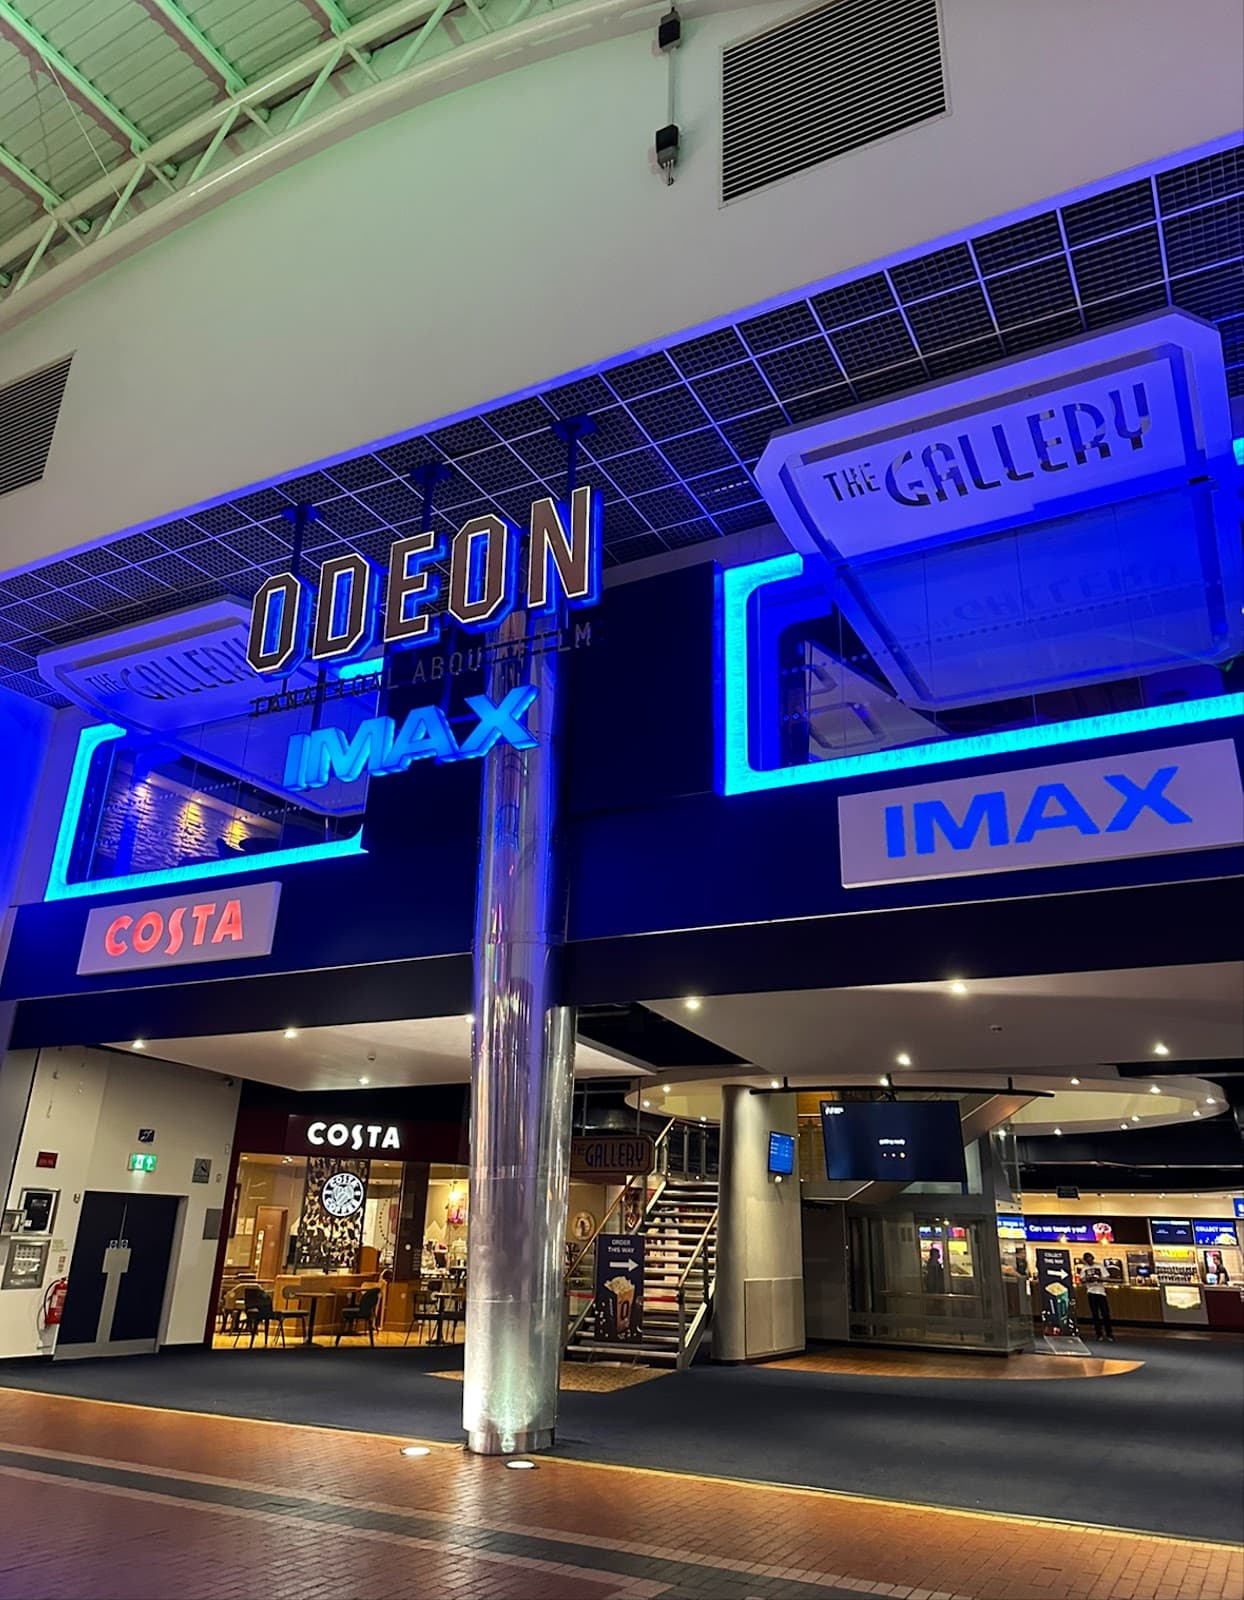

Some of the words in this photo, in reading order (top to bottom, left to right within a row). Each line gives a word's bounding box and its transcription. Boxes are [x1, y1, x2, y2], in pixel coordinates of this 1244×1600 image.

[823, 462, 881, 502] THE
[885, 382, 1152, 507] GALLERY
[246, 485, 597, 673] ODEON
[84, 672, 127, 697] THE
[282, 685, 541, 792] IMAX
[884, 765, 1193, 859] IMAX
[105, 899, 245, 957] COSTA
[307, 1121, 400, 1151] COSTA
[585, 1140, 645, 1169] GALLERY
